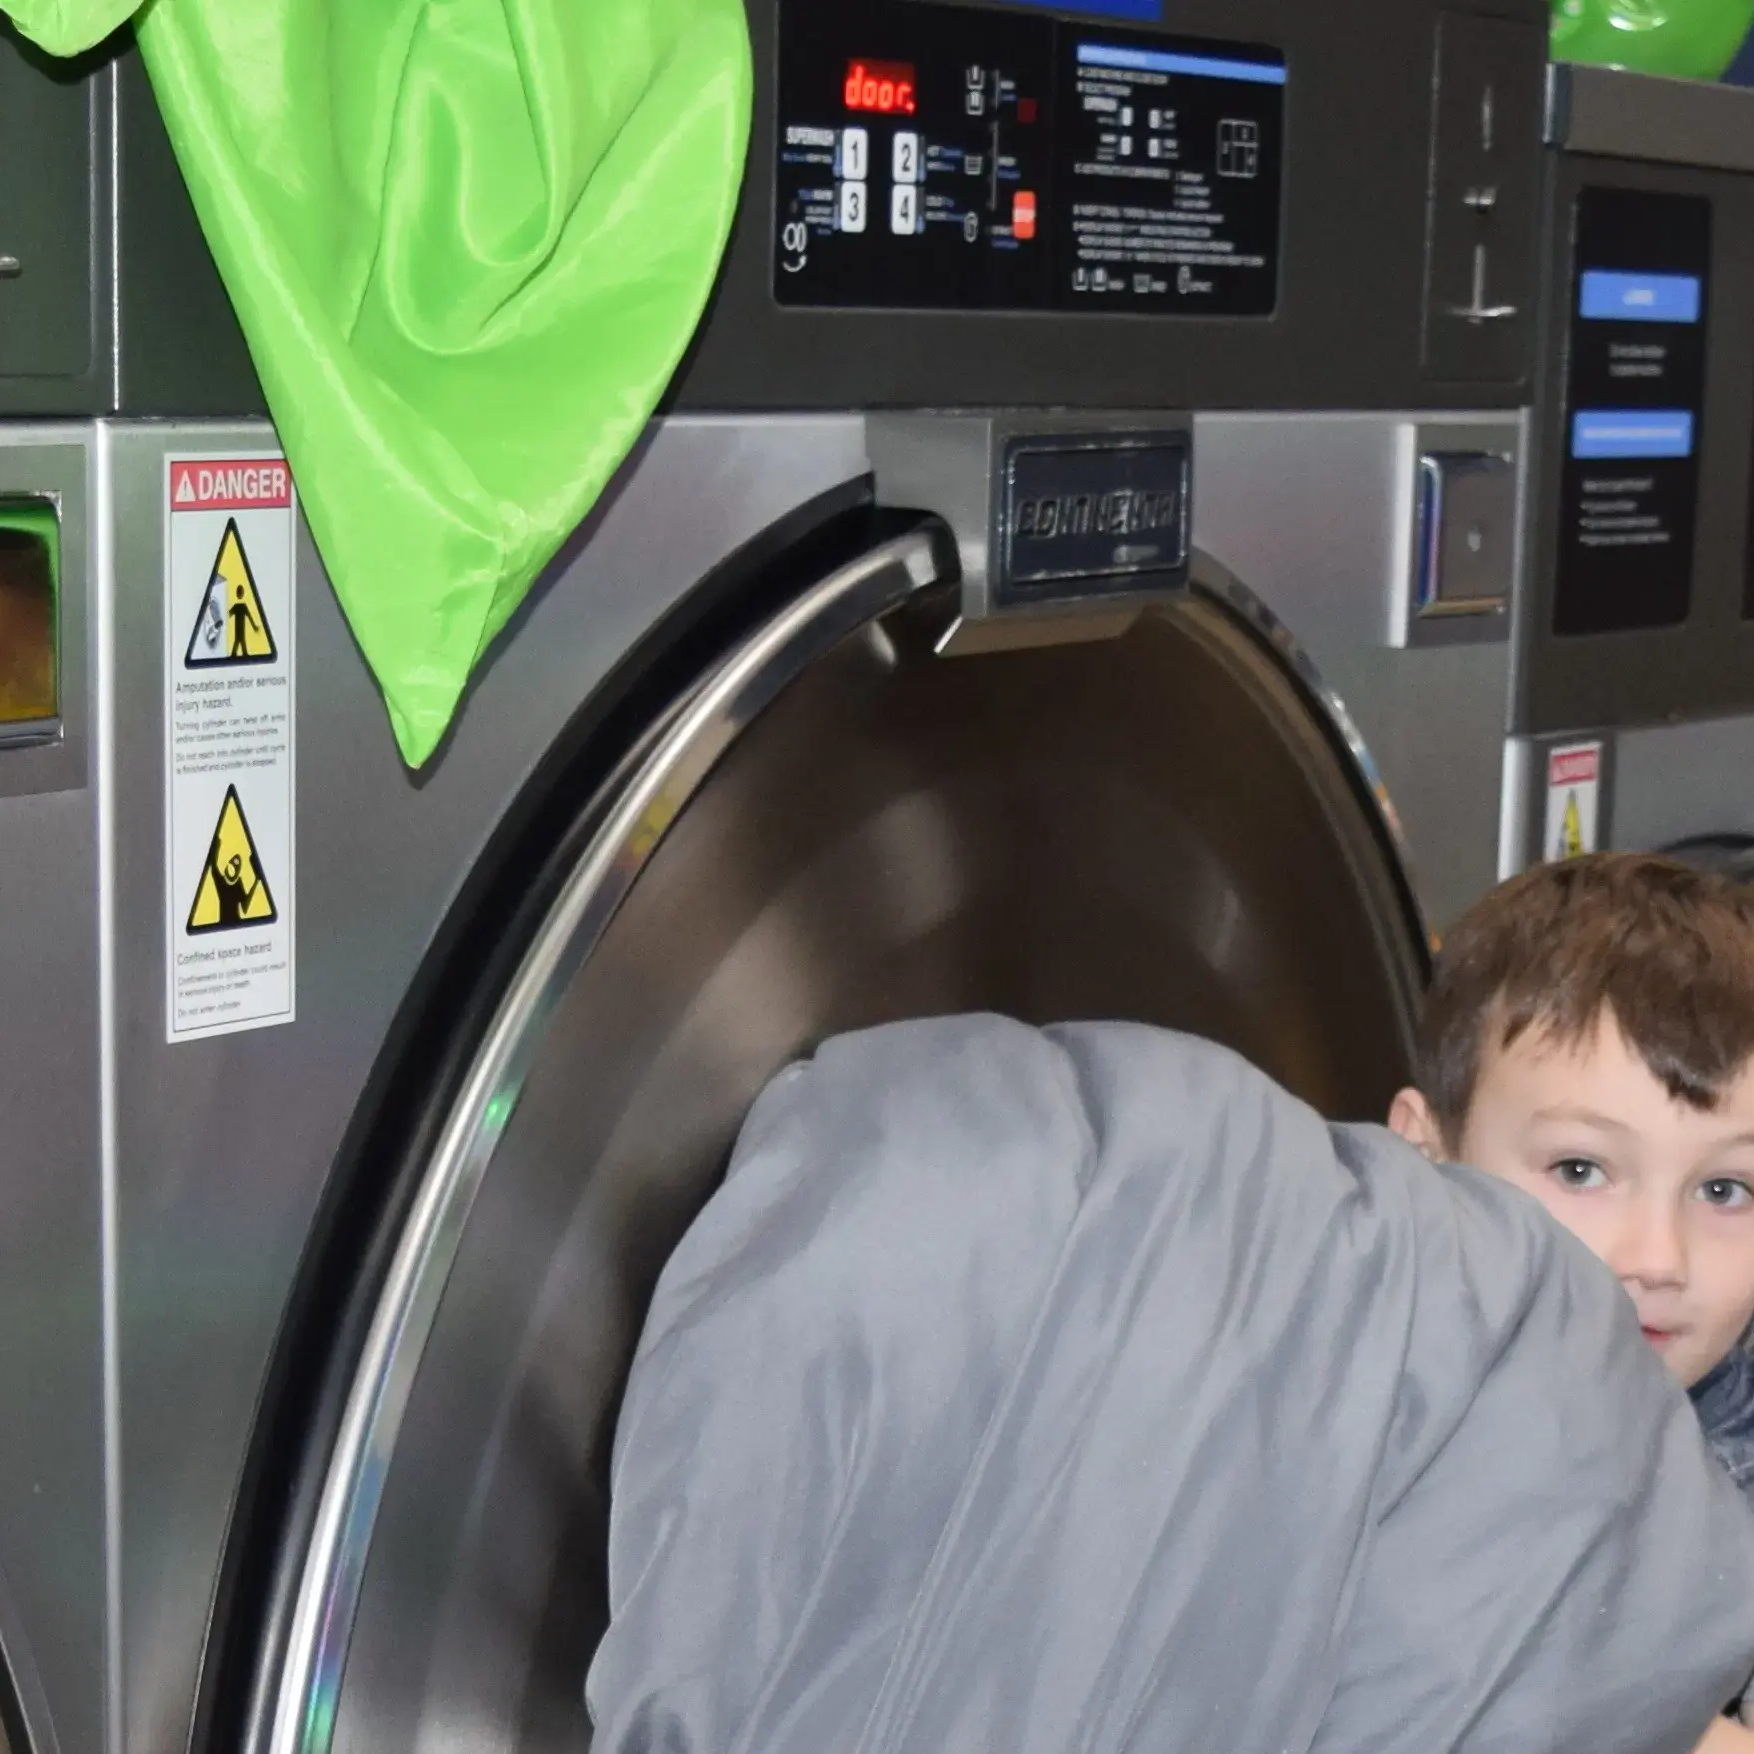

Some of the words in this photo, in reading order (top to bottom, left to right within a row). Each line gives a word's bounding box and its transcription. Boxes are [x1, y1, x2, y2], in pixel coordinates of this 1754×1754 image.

[852, 140, 859, 170] 1
[901, 143, 911, 172] 2
[848, 192, 858, 221] 3
[900, 195, 910, 224] 4
[198, 468, 286, 500] DANGER
